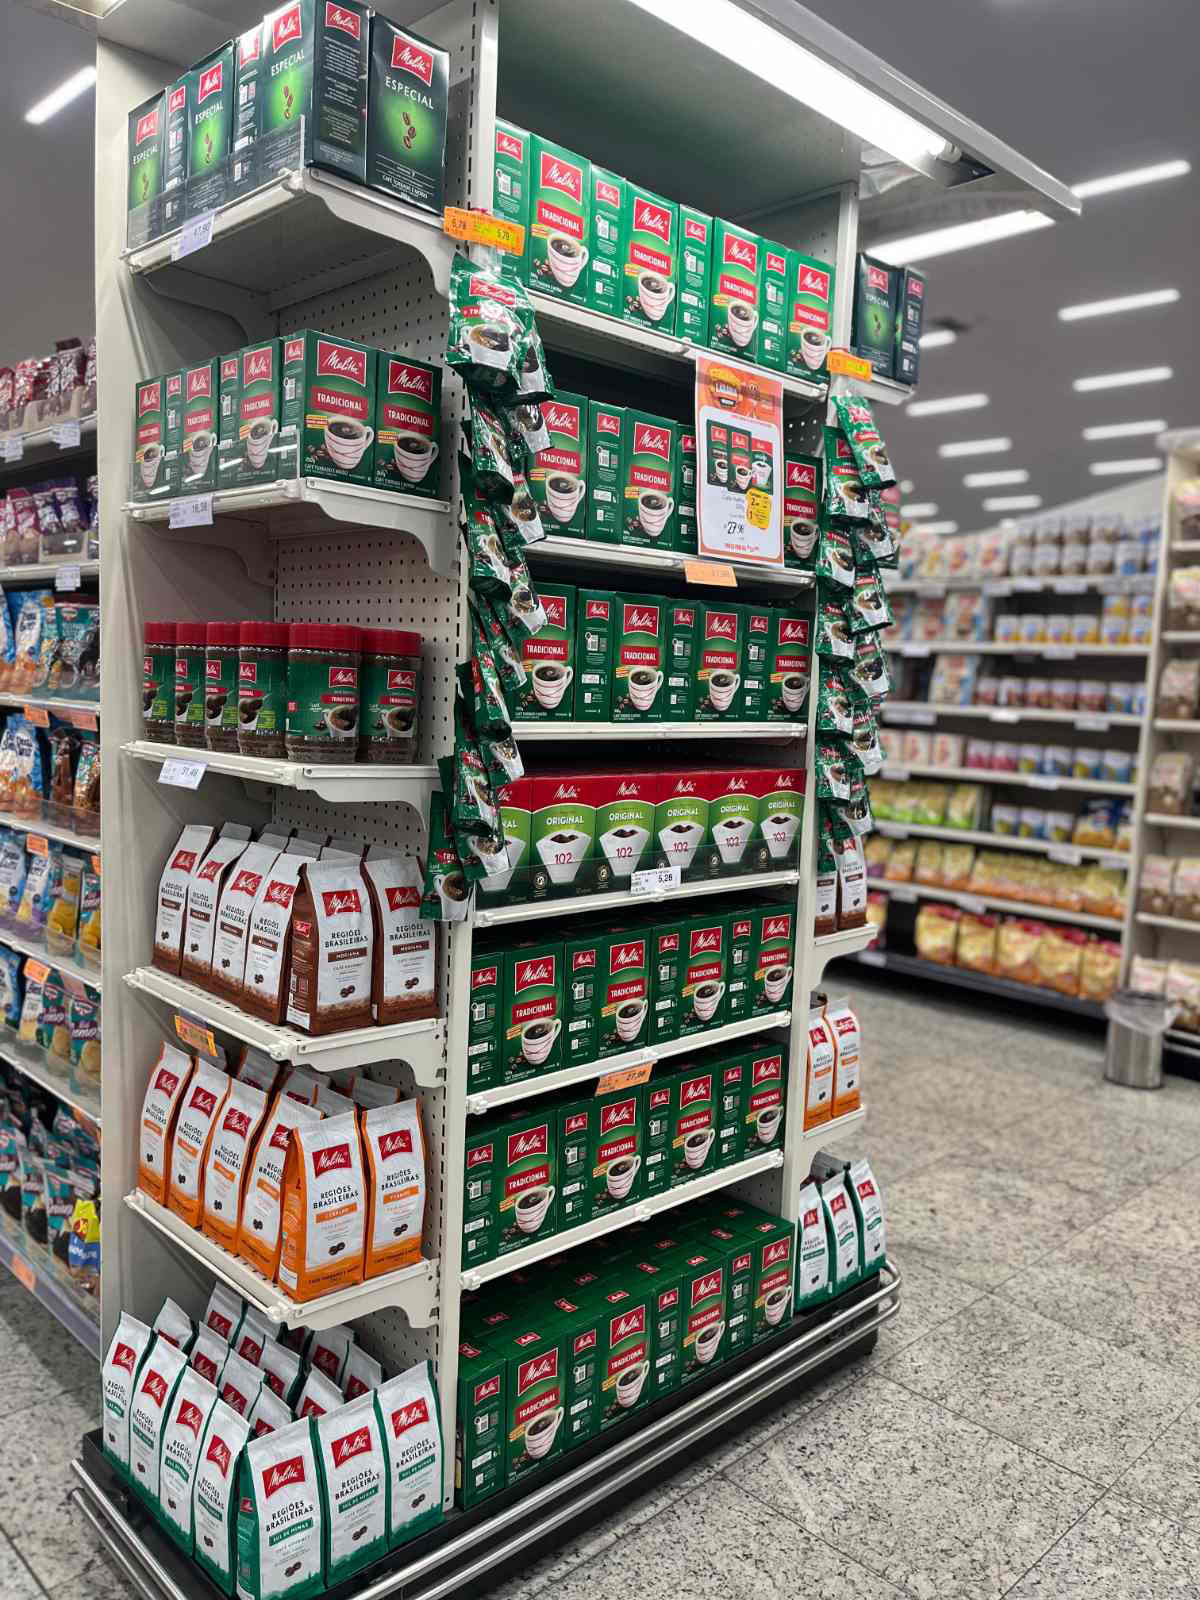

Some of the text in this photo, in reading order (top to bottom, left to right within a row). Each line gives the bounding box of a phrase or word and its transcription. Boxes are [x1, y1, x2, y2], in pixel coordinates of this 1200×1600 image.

[274, 16, 298, 38] Melitta
[331, 11, 356, 30] Melitta
[271, 50, 305, 76] ESPECIAL
[397, 48, 430, 74] Melitta
[201, 72, 221, 95] Melitta
[385, 76, 434, 109] ESPECIAL
[196, 102, 224, 125] ESPECIAL
[545, 162, 576, 193] Melitta
[541, 206, 581, 233] TRADICIONAL
[639, 207, 665, 231] Melitta
[633, 248, 669, 269] TRADICIONAL
[730, 240, 752, 263] Melitta
[804, 272, 824, 293] Melitta
[248, 356, 269, 375] Melitta
[323, 349, 361, 375] Melitta
[396, 367, 430, 392] Melitta
[243, 399, 272, 413] TRADICIONAL
[317, 392, 363, 411] TRADICIONAL
[387, 408, 430, 428] TRADICIONAL
[547, 406, 574, 430] Melitta
[640, 430, 666, 451] Melitta
[539, 452, 578, 467] TRADICIONAL
[633, 472, 668, 486] TRADICIONAL
[792, 469, 812, 484] Melitta
[629, 612, 654, 632] Melitta
[708, 619, 733, 636] Melitta
[783, 625, 807, 640] Melitta
[526, 643, 564, 656] TRADICIONAL
[623, 650, 657, 662] TRADICIONAL
[705, 655, 735, 665] TRADICIONAL
[334, 670, 354, 683] Melitta
[615, 781, 639, 798] Melitta
[673, 778, 695, 794] Melitta
[727, 776, 748, 791] Melitta
[774, 774, 793, 788] Melitta
[552, 783, 578, 800] Melitta
[667, 808, 699, 817] ORIGINAL
[719, 804, 750, 813] ORIGINAL
[768, 800, 797, 809] ORIGINAL
[546, 815, 585, 826] ORIGINAL
[609, 811, 645, 822] ORIGINAL
[616, 846, 633, 859] 102
[672, 842, 689, 854] 102
[554, 852, 574, 865] 102
[329, 893, 355, 911] Melitta
[393, 890, 417, 905] Melitta
[220, 909, 246, 925] BRASILEIRAS
[225, 904, 245, 916] REGIÕES
[253, 922, 281, 938] BRASILEIRAS
[259, 916, 279, 929] REGIÕES
[396, 923, 423, 933] REGIÕES
[766, 919, 786, 935] Melitta
[325, 935, 368, 948] BRASILEIRAS
[331, 929, 361, 940] REGIÕES
[389, 930, 431, 941] BRASILEIRAS
[695, 933, 717, 949] Melitta
[616, 946, 640, 965] Melitta
[761, 952, 787, 964] TRADICIONAL
[519, 964, 550, 985] Melitta
[689, 967, 720, 980] TRADICIONAL
[610, 984, 642, 999] TRADICIONAL
[516, 1003, 553, 1017] TRADICIONAL
[756, 1062, 777, 1077] Melitta
[686, 1083, 707, 1099] Melitta
[606, 1107, 631, 1125] Melitta
[680, 1114, 710, 1130] TRADICIONAL
[178, 1126, 202, 1146] BRASILEIRAS
[183, 1120, 202, 1137] REGIÕES
[220, 1144, 240, 1160] REGIÕES
[384, 1136, 408, 1154] Melitta
[512, 1135, 544, 1155] Melitta
[601, 1140, 635, 1158] TRADICIONAL
[214, 1149, 241, 1170] BRASILEIRAS
[317, 1150, 346, 1171] Melitta
[381, 1173, 420, 1191] BRASILEIRAS
[386, 1168, 412, 1181] REGIÕES
[508, 1171, 546, 1190] TRADICIONAL
[313, 1189, 359, 1209] BRASILEIRAS
[320, 1183, 352, 1200] REGIÕES
[767, 1246, 787, 1262] Melitta
[697, 1279, 718, 1296] Melitta
[615, 1316, 640, 1337] Melitta
[691, 1310, 720, 1328] TRADICIONAL
[610, 1349, 643, 1370] TRADICIONAL
[521, 1359, 552, 1386] Melitta
[519, 1392, 557, 1419] TRADICIONAL
[136, 1408, 154, 1427] REGIÕES
[397, 1407, 423, 1427] Melitta
[339, 1436, 367, 1461] Melitta
[396, 1441, 437, 1469] BRASILEIRAS
[401, 1438, 430, 1459] REGIÕES
[166, 1445, 193, 1471] BRASILEIRAS
[269, 1463, 298, 1490] Melitta
[341, 1468, 373, 1489] REGIÕES
[197, 1480, 225, 1509] BRASILEIRAS
[201, 1477, 220, 1498] REGIÕES
[335, 1473, 381, 1501] BRASILEIRAS
[266, 1504, 314, 1533] BRASILEIRAS
[271, 1499, 305, 1521] REGIÕES
